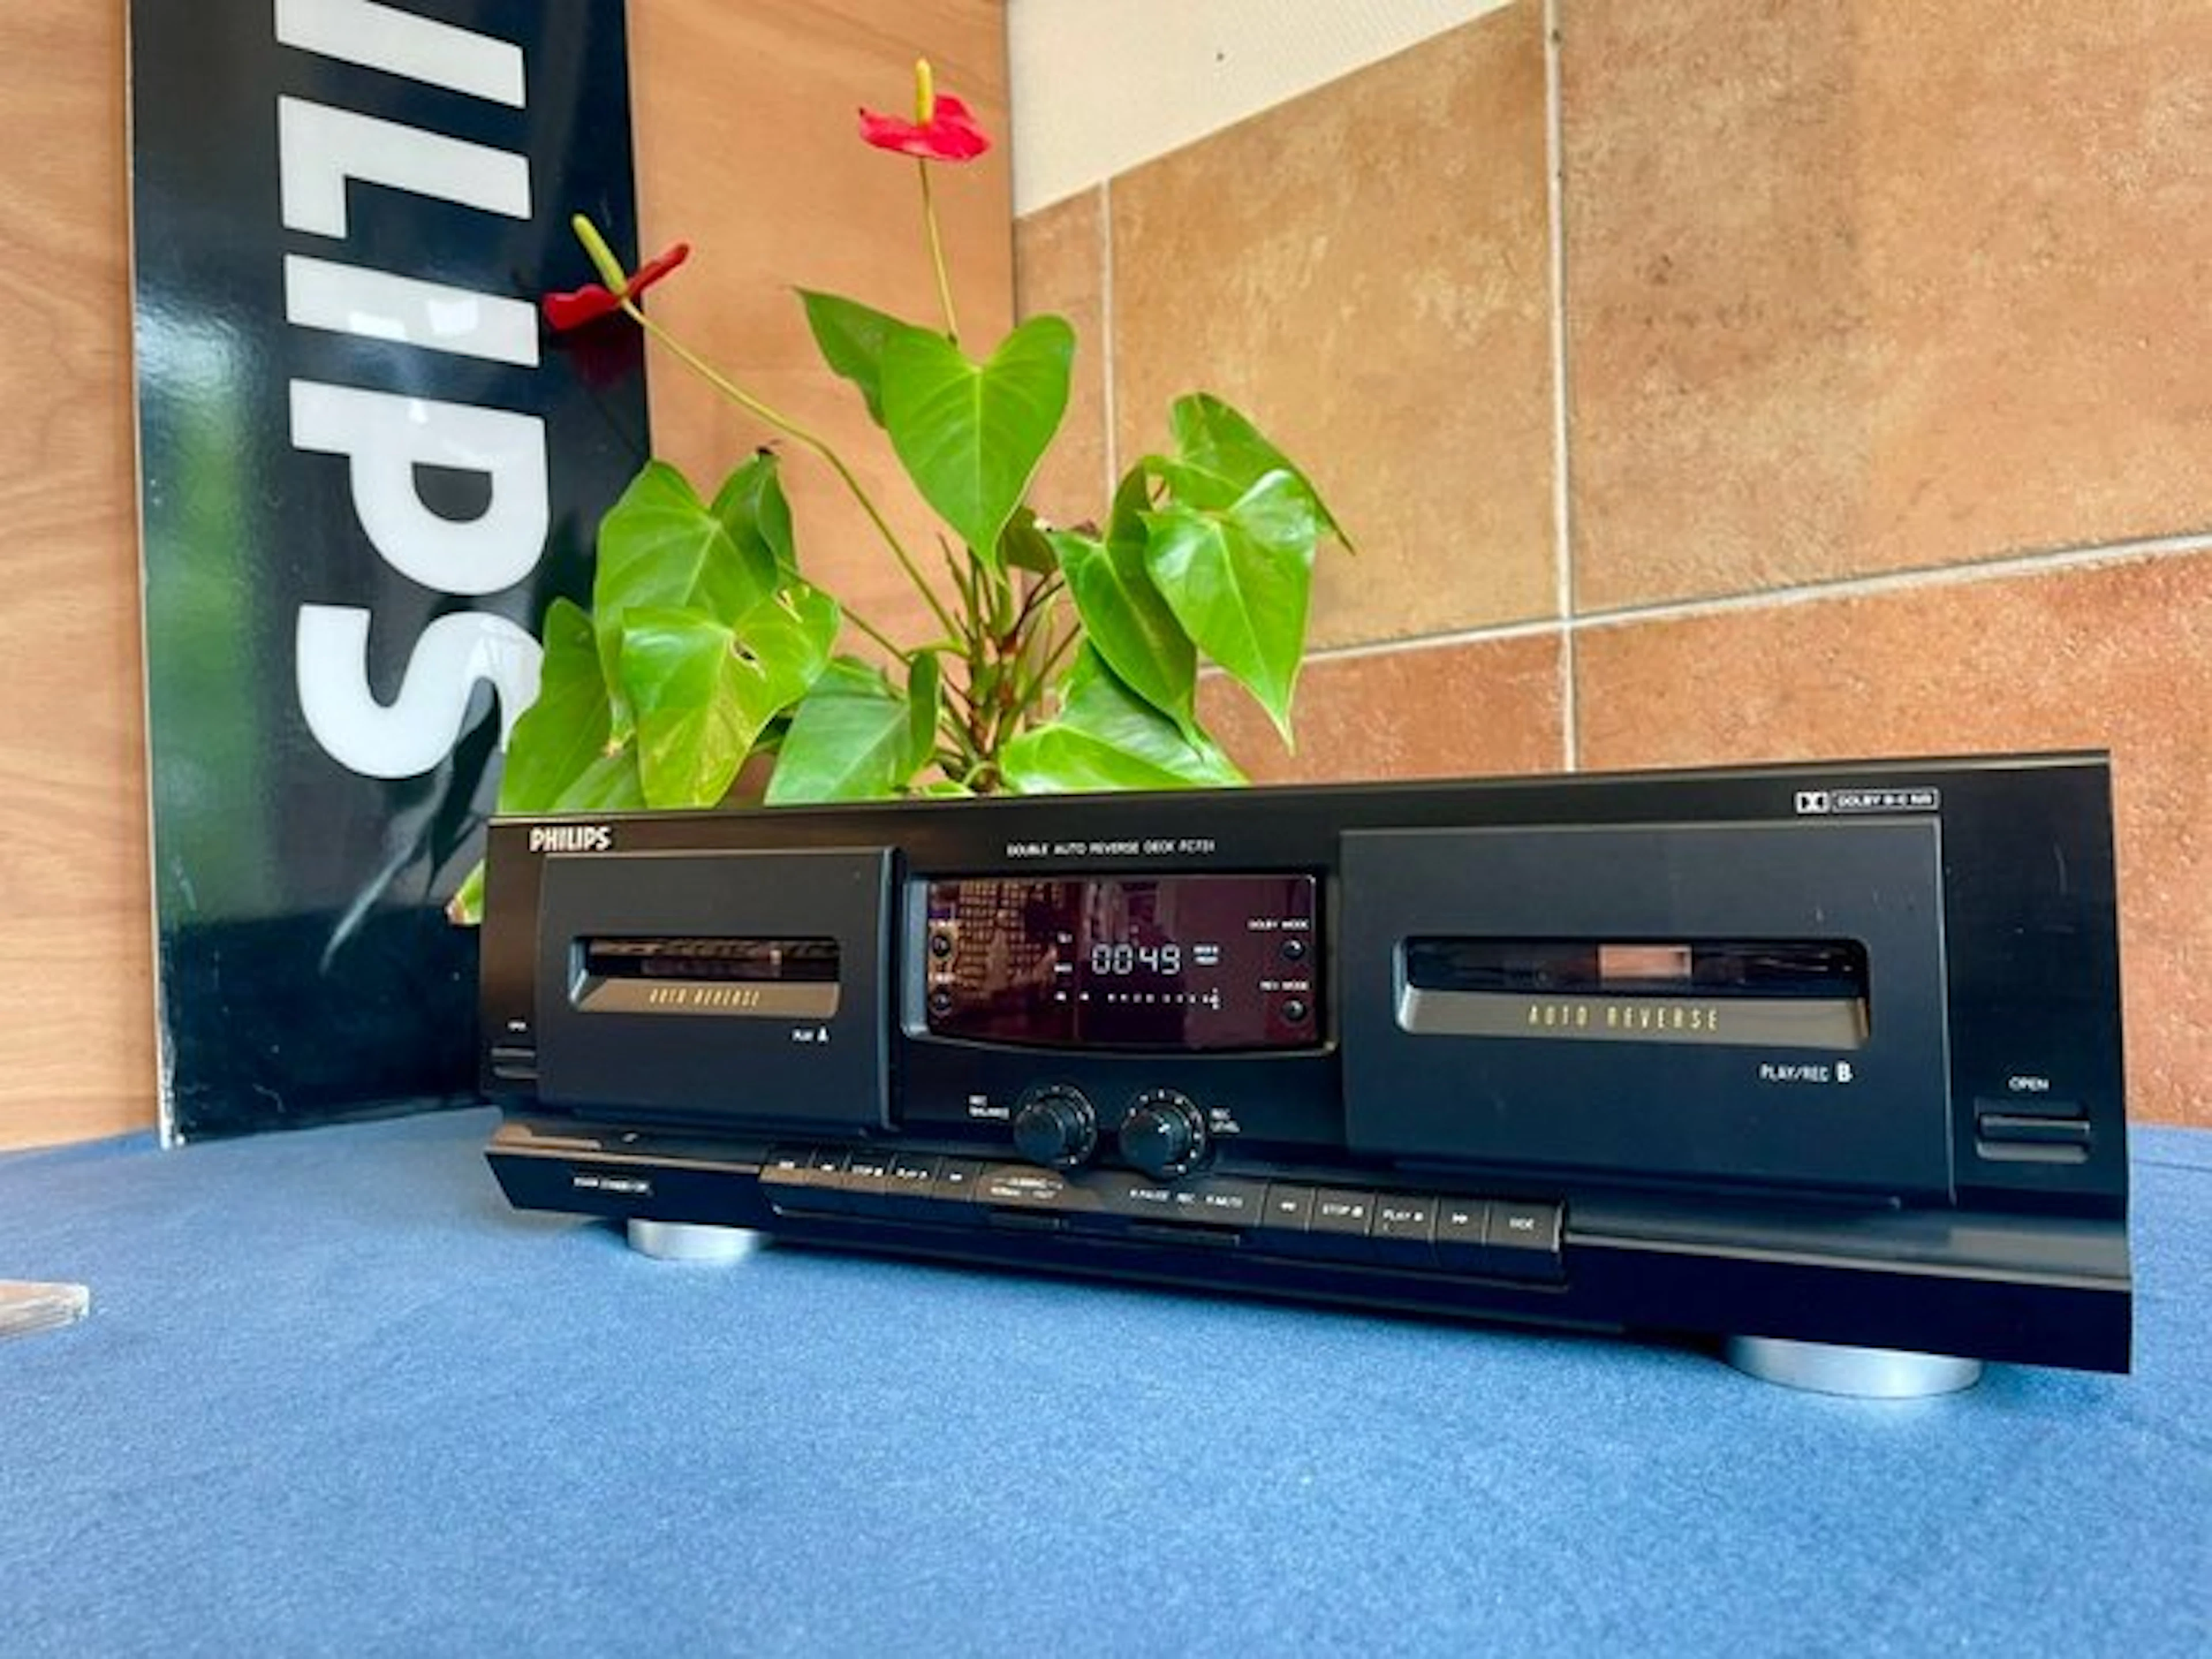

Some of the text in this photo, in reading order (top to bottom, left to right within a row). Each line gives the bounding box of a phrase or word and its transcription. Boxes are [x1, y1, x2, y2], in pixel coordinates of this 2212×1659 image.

[530, 826, 611, 851] PHILIPS
[1006, 841, 1048, 857] DOUBLE
[1054, 841, 1086, 855] AUTO
[1089, 841, 1139, 855] REVERSE
[1143, 839, 1176, 854] DECK
[1091, 944, 1180, 975] 0049
[1528, 1005, 1718, 1030] AUTO REVERSE
[1759, 1060, 1854, 1083] PLAY/REC B
[2008, 1075, 2050, 1092] OPEN
